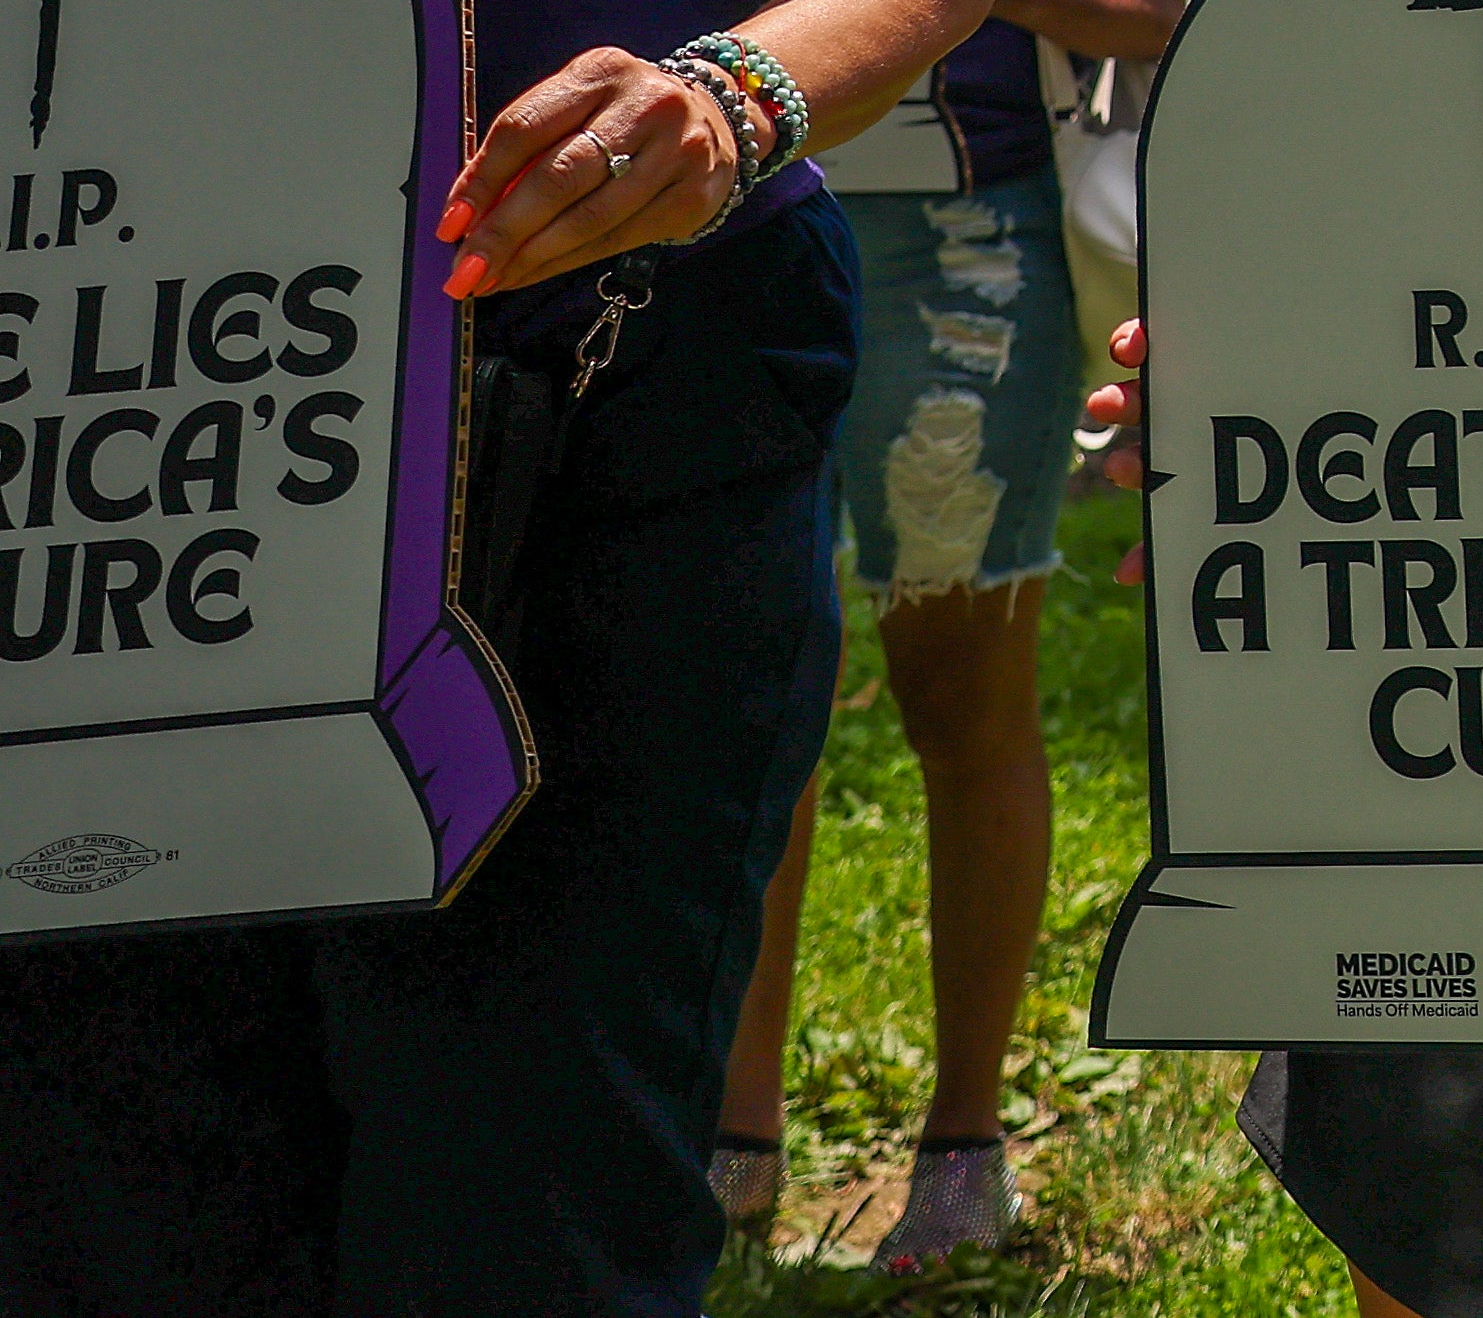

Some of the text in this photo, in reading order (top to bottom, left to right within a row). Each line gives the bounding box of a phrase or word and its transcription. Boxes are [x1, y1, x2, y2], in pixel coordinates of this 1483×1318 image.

[65, 263, 364, 397] LIES
[1191, 540, 1271, 653] A
[83, 837, 132, 852] PRINTING
[16, 855, 151, 875] TRADES COUNCIL
[165, 850, 180, 862] 81
[1336, 952, 1477, 977] MEDICAID
[1336, 978, 1477, 999] SAVES LIVES
[1336, 1003, 1479, 1018] Hands Off Medicaid
